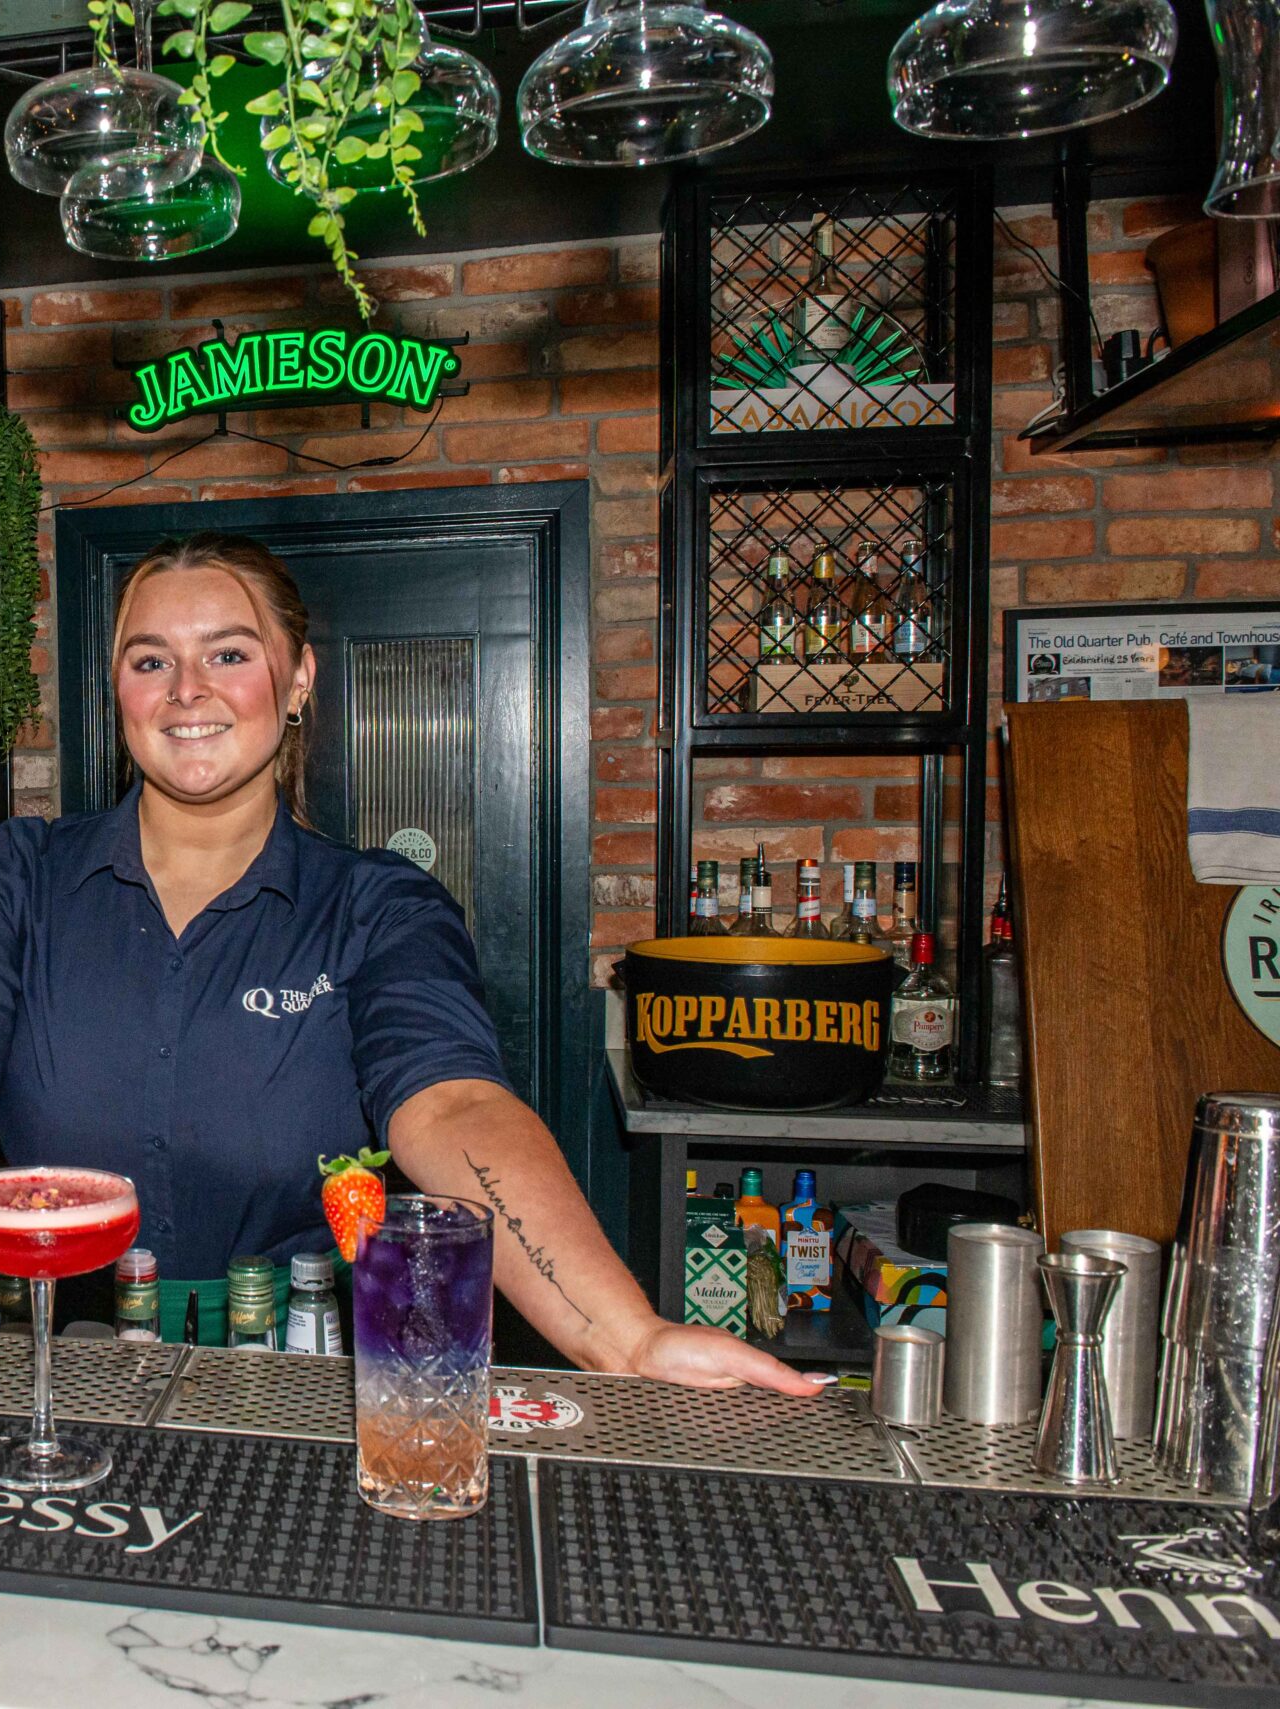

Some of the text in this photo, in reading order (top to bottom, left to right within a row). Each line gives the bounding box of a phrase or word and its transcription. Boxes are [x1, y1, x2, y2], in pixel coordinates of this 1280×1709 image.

[713, 400, 944, 432] CASAMIGOS
[1028, 630, 1280, 649] The Old Quarter Pub, Café and Townhous
[636, 992, 880, 1056] KOPPARBERG
[789, 1245, 827, 1259] TWIST
[693, 1286, 738, 1299] Maldon
[892, 1556, 1280, 1640] Henn
